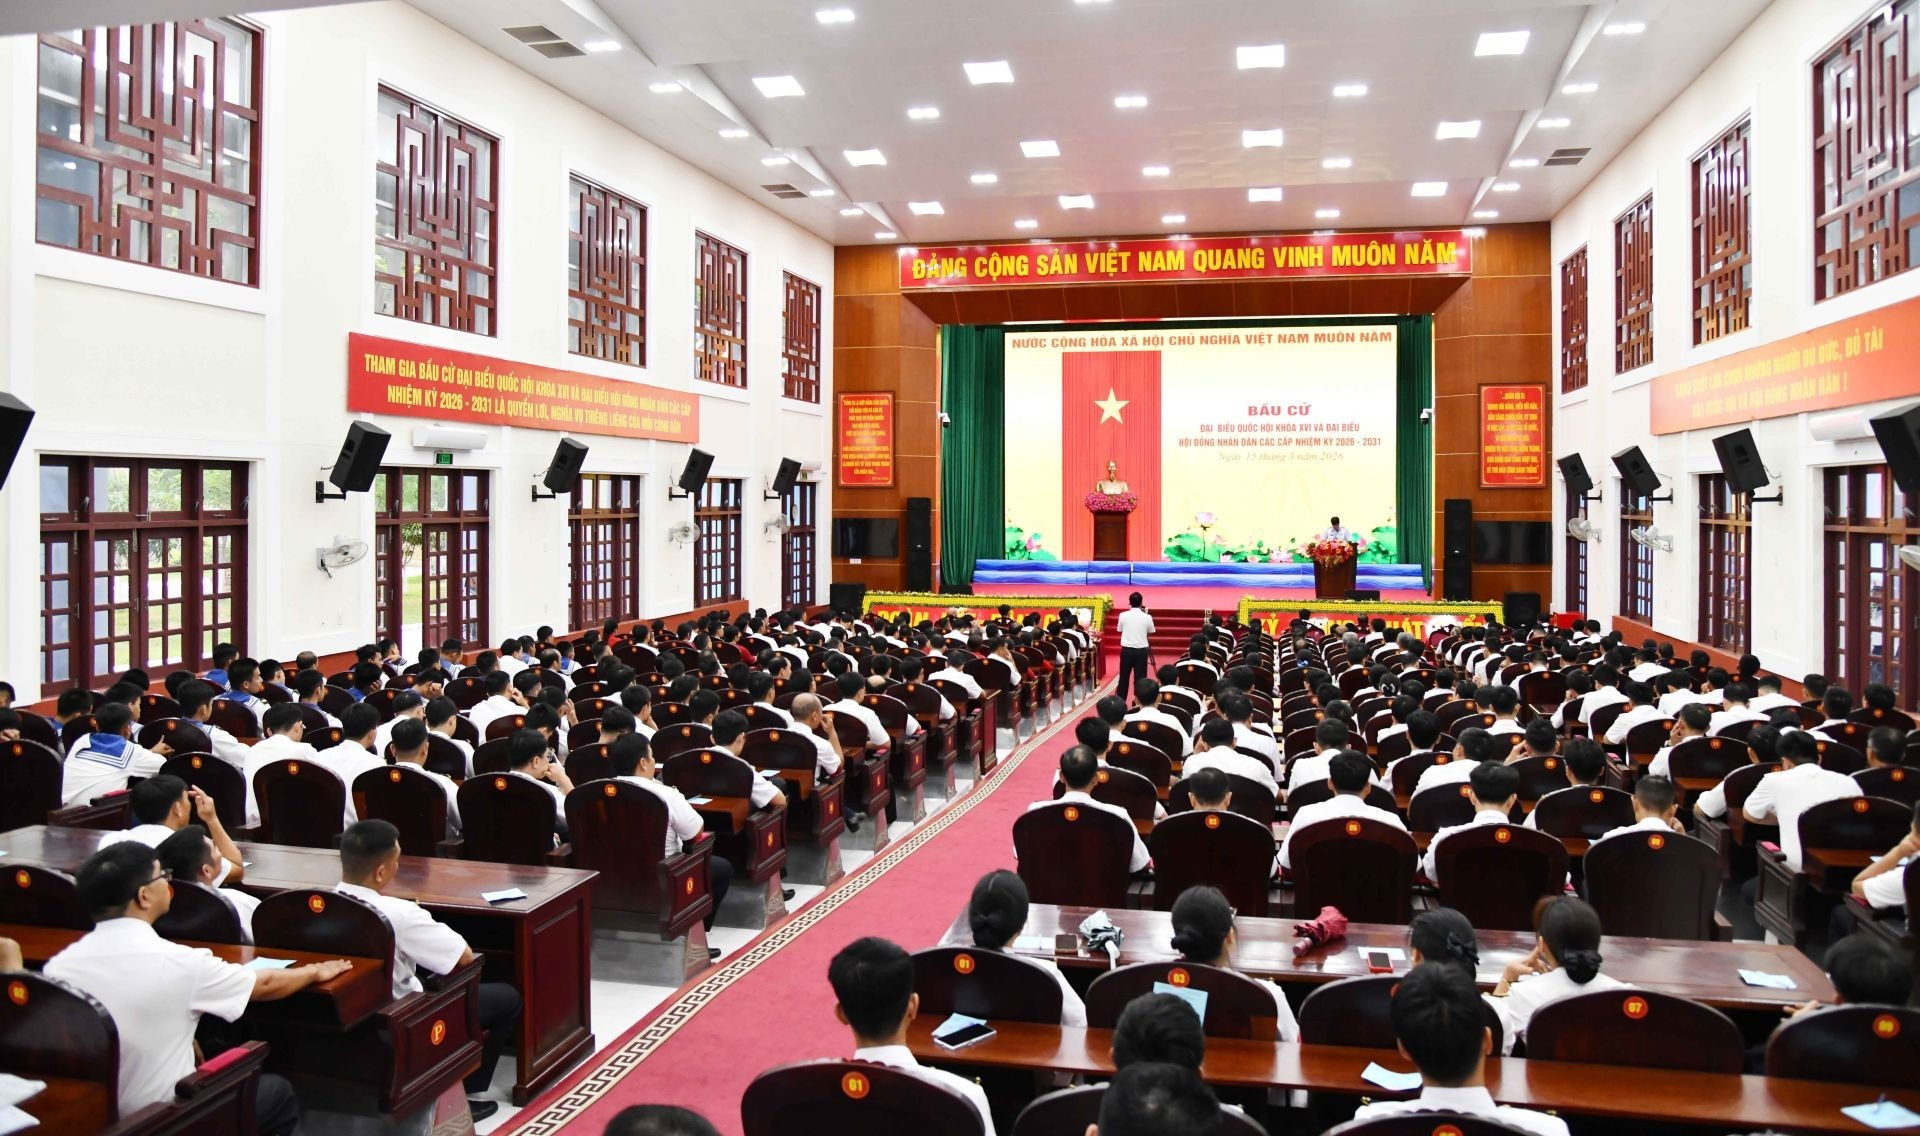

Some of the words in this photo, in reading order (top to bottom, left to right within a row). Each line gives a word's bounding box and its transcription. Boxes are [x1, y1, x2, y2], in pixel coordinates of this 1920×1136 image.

[912, 253, 968, 279] ĐẢNG
[974, 252, 1029, 281] CỘNG
[1036, 248, 1078, 275] SẢN
[1085, 248, 1131, 277] VIỆT
[1138, 250, 1185, 272] NAM
[1192, 248, 1265, 274] QUANG
[1272, 245, 1324, 268] VINH
[1331, 240, 1396, 267] MUÔN
[1404, 238, 1457, 265] NĂM
[1012, 337, 1046, 349] NƯỚC
[1051, 336, 1087, 349] CỘNG
[1091, 335, 1117, 347] HÒA
[1121, 335, 1138, 346] XÃ
[1142, 335, 1164, 348] HỘI
[1168, 333, 1195, 345] CHỦ
[1199, 333, 1241, 345] NGHĨA
[1245, 332, 1273, 346] VIỆT
[1277, 333, 1309, 344] NAM
[1314, 331, 1355, 343] MUÔN
[1359, 330, 1392, 342] NĂM
[1845, 328, 1861, 358] ĐỦ
[1863, 325, 1883, 353] TÀI
[364, 353, 396, 375] THAM
[398, 359, 416, 379] GIA
[419, 358, 439, 382] BẦU
[441, 361, 456, 384] CỬ
[457, 368, 472, 389] ĐẠI
[474, 366, 495, 389] BIỂU
[497, 371, 519, 392] QUỐC
[521, 376, 534, 397] HỘI
[557, 383, 569, 399] XVI
[570, 384, 580, 400] VÀ
[387, 384, 422, 408] NHIỆM
[424, 387, 438, 407] KỲ
[440, 392, 463, 410] 2026
[471, 395, 492, 413] 2031
[495, 396, 505, 415] LÀ
[1248, 402, 1281, 416] BẦU
[1287, 402, 1312, 416] CỬ
[1200, 424, 1213, 434] ĐẠI
[1237, 422, 1258, 432] QUỐC
[1260, 422, 1273, 433] HỘI
[1299, 423, 1311, 432] XVI
[1326, 423, 1339, 433] ĐẠI
[1295, 436, 1321, 447] NHIỆM
[1336, 437, 1355, 446] 2026
[1362, 437, 1381, 446] 2031
[1349, 824, 1358, 832] 05
[1498, 832, 1507, 840] 07
[313, 899, 323, 909] 02
[959, 958, 970, 970] 01
[1173, 973, 1185, 984] 03
[1628, 1002, 1642, 1014] 07
[434, 1025, 444, 1042] P
[849, 1079, 863, 1093] 01
